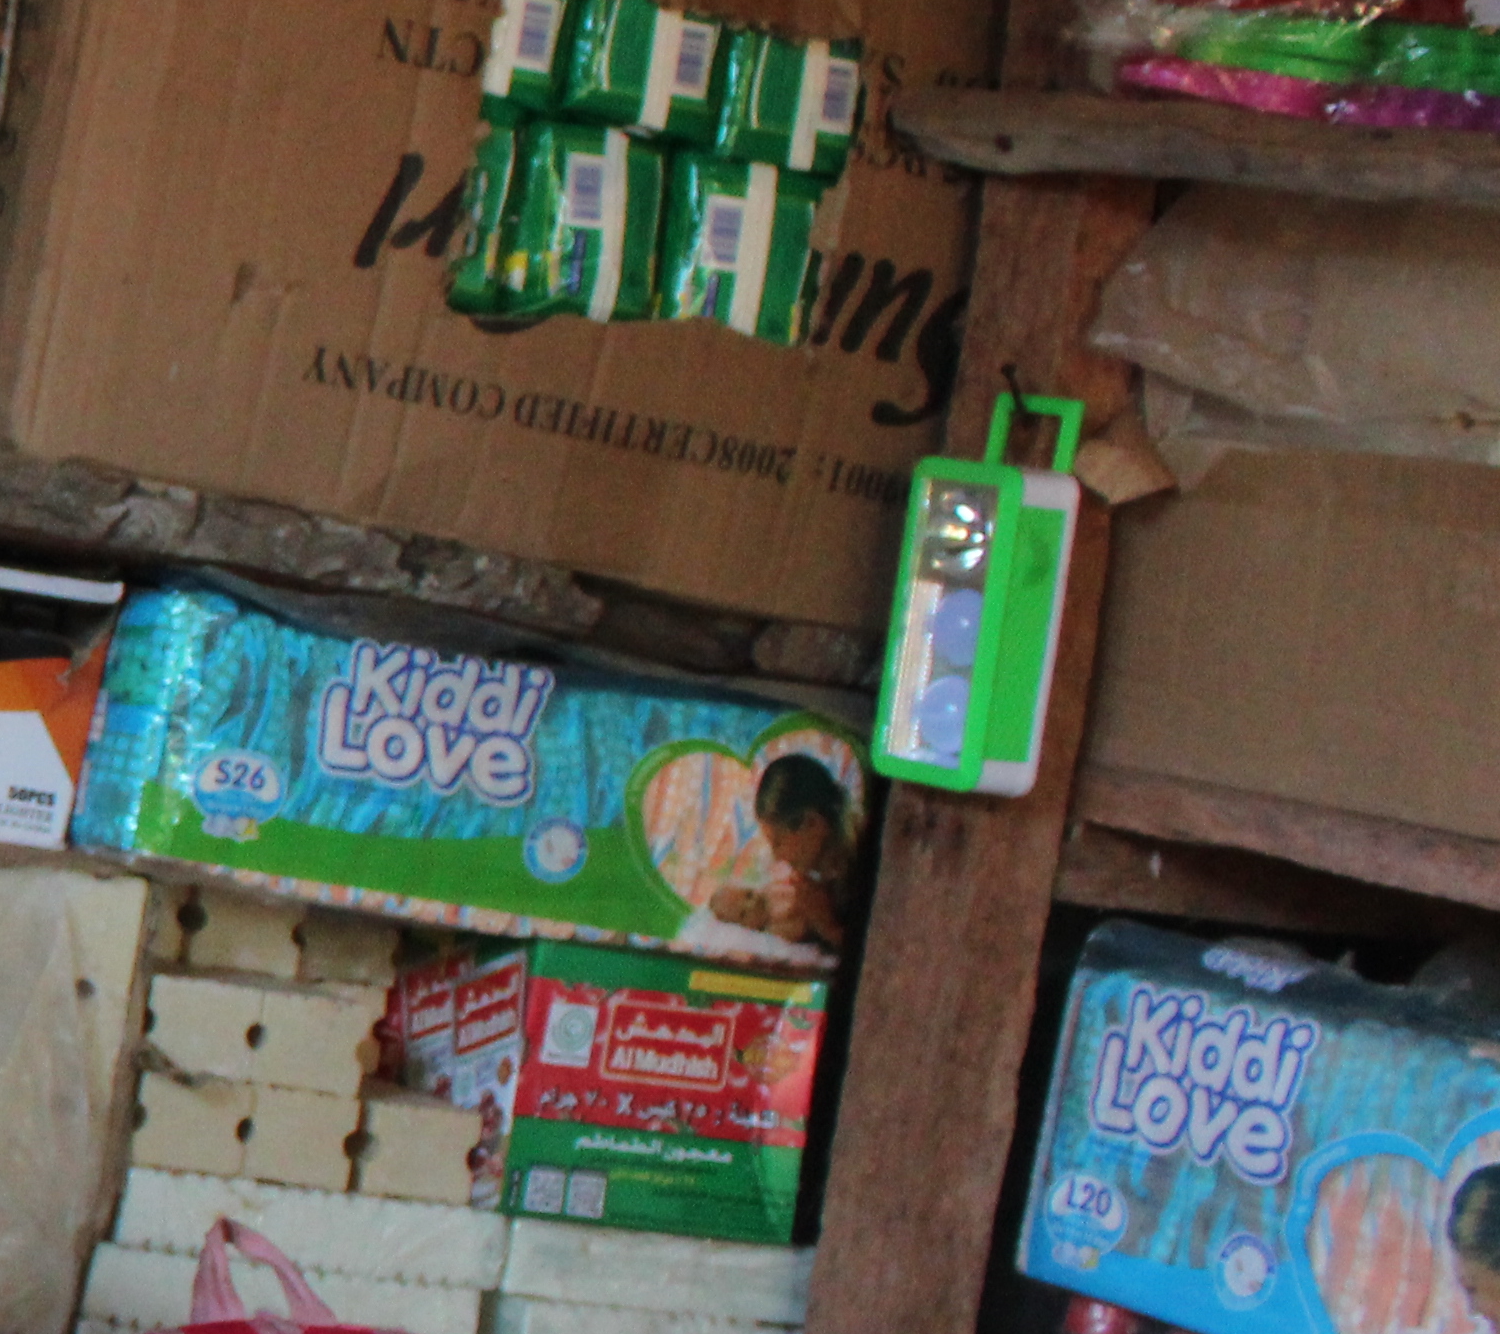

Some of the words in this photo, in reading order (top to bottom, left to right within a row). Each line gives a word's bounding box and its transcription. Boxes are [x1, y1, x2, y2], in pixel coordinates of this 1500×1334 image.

[303, 346, 504, 418] COMPANY
[353, 641, 553, 735] Kiddi
[214, 759, 266, 791] S26
[320, 682, 532, 804] Love
[1127, 983, 1317, 1106] Kiddi
[1092, 1032, 1290, 1184] Love
[1065, 1180, 1112, 1219] L20
